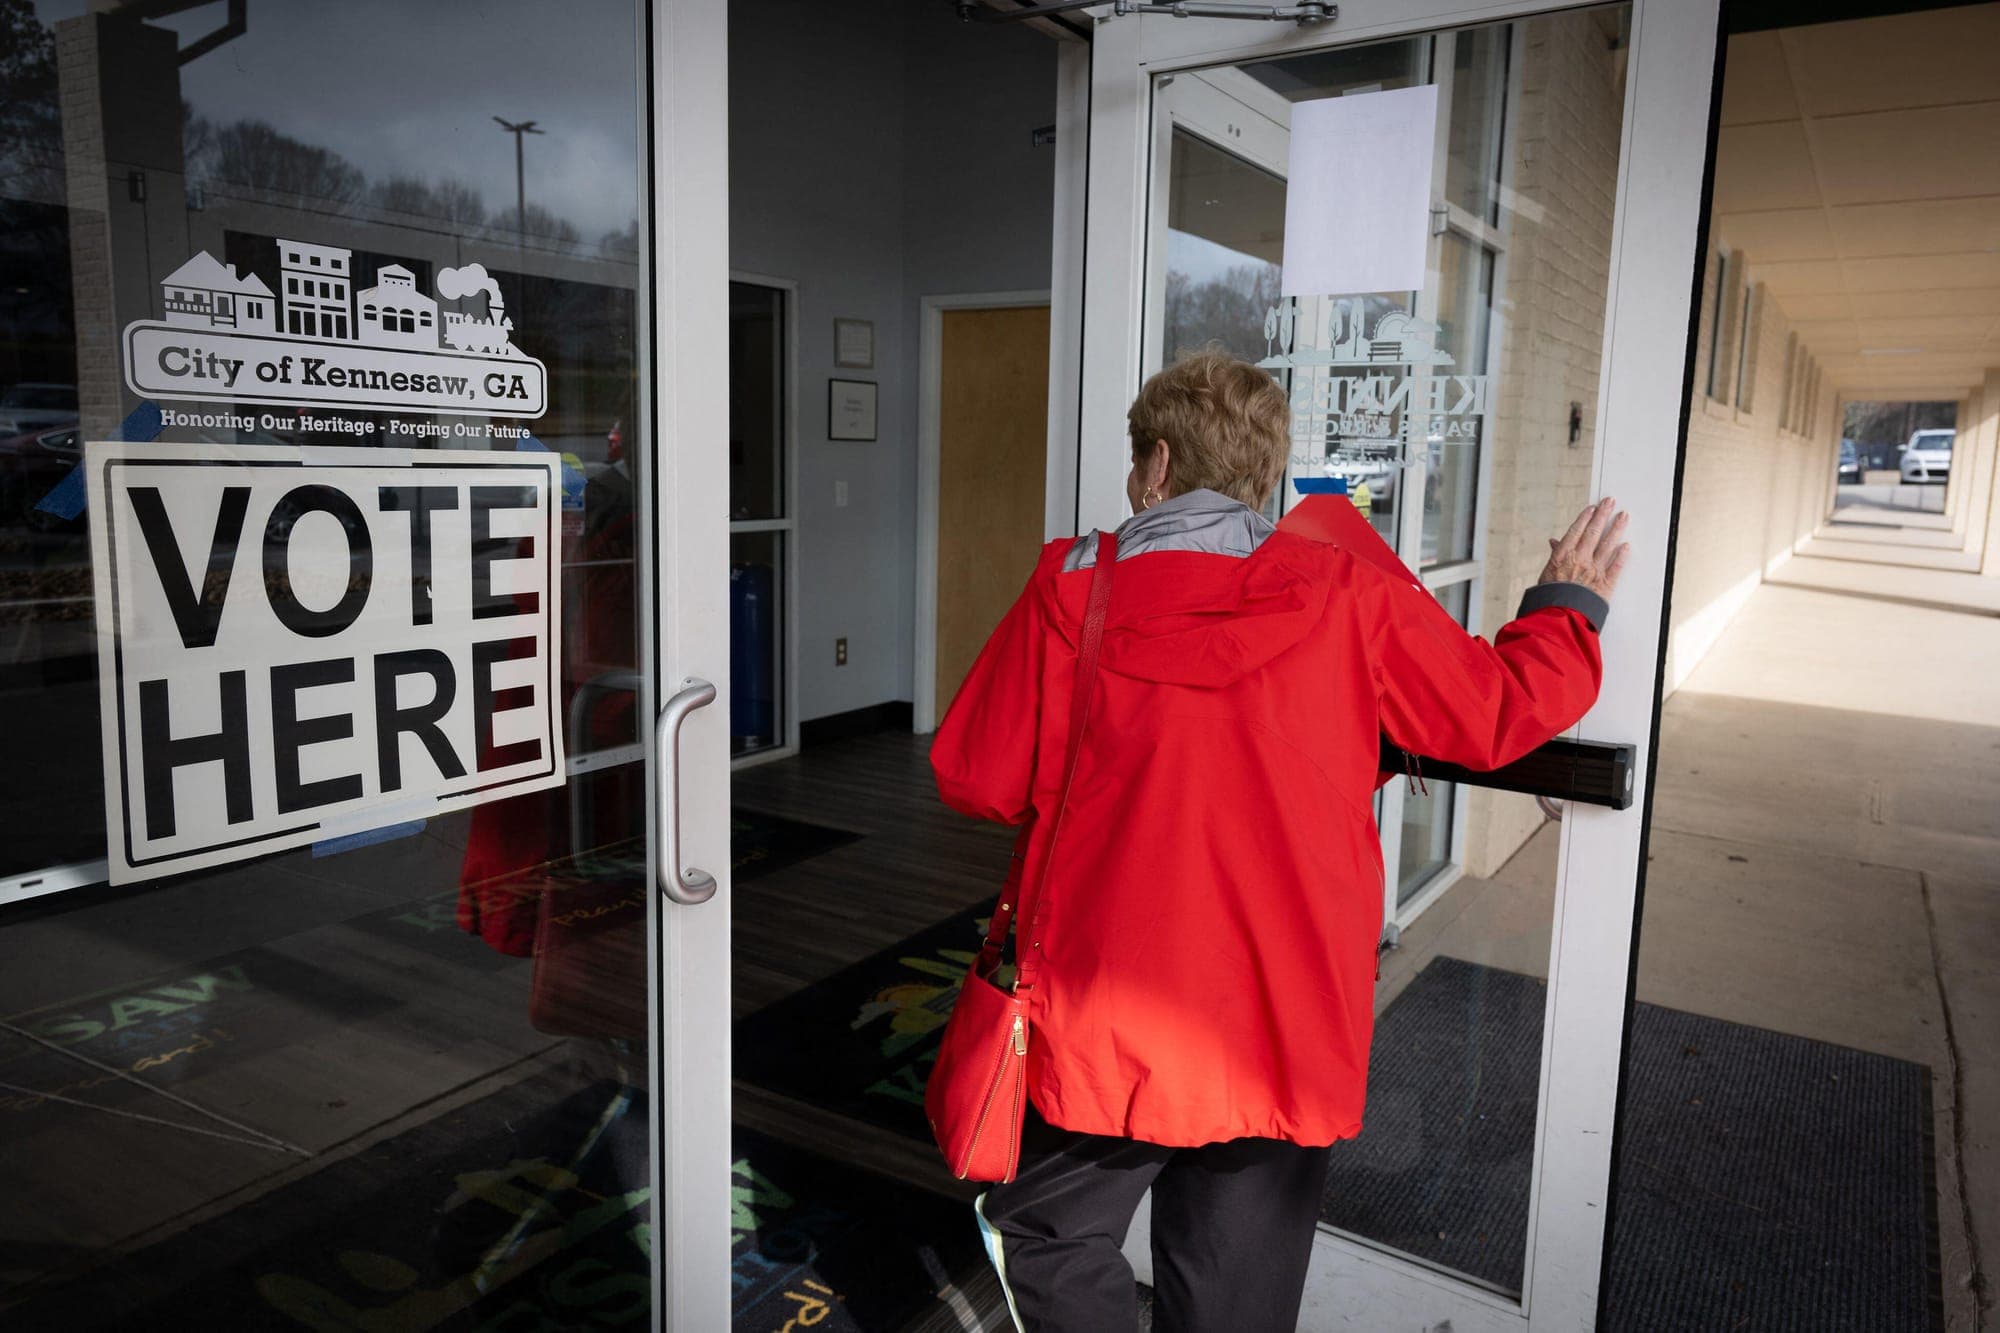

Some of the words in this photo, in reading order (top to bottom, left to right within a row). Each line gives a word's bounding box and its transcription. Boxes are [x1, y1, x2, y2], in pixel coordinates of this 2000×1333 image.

[158, 346, 244, 387] City
[255, 356, 293, 384] of
[301, 357, 475, 400] Kennesaw,
[484, 373, 529, 400] GA
[160, 409, 255, 431] Honoring
[261, 414, 295, 431] Our
[300, 416, 375, 436] Heritage
[389, 420, 450, 437] Forging
[454, 423, 481, 438] Our
[485, 424, 531, 440] Future
[126, 484, 540, 649] VOTE
[139, 635, 543, 841] HERE
